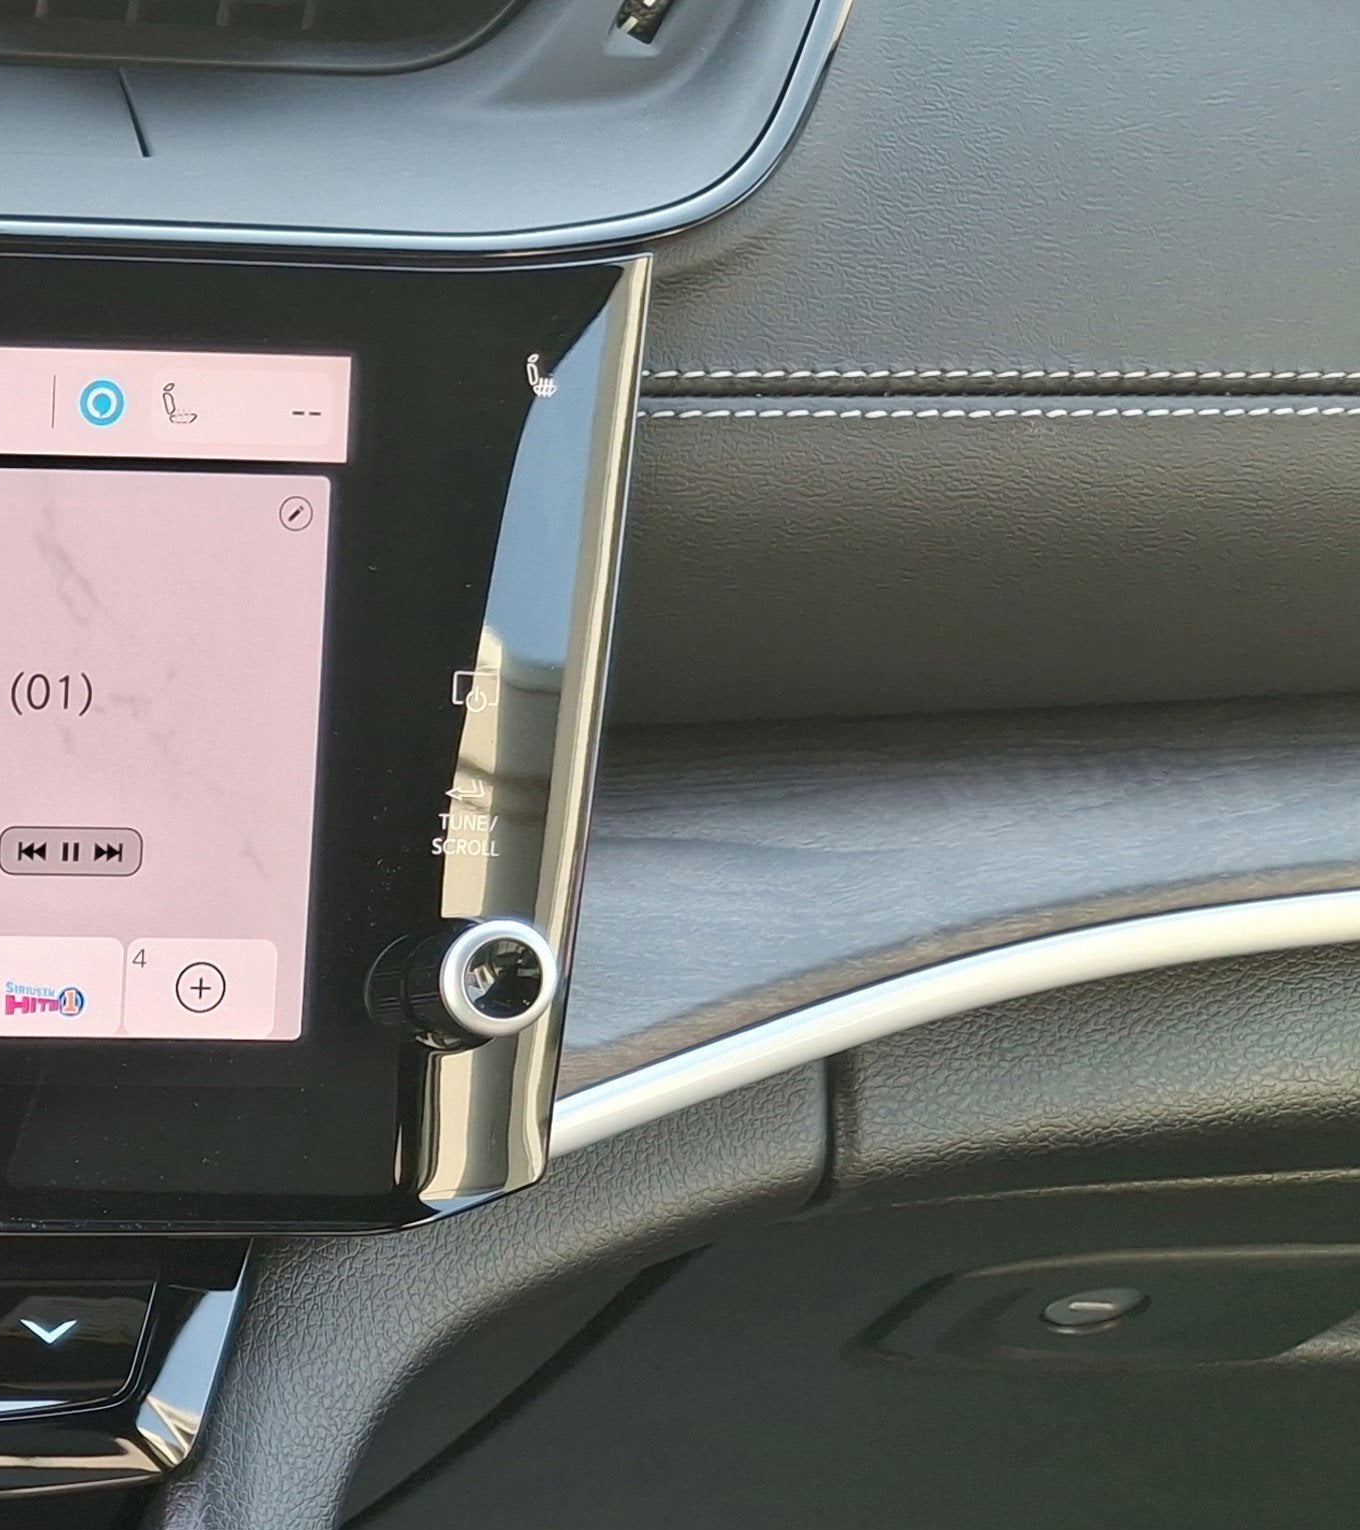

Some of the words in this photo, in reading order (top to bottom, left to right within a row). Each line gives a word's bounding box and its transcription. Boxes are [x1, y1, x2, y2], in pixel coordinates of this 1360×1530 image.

[11, 672, 92, 716] (01)
[438, 813, 499, 832] TUNE/
[431, 836, 501, 857] SCROLL
[132, 949, 146, 968] 4
